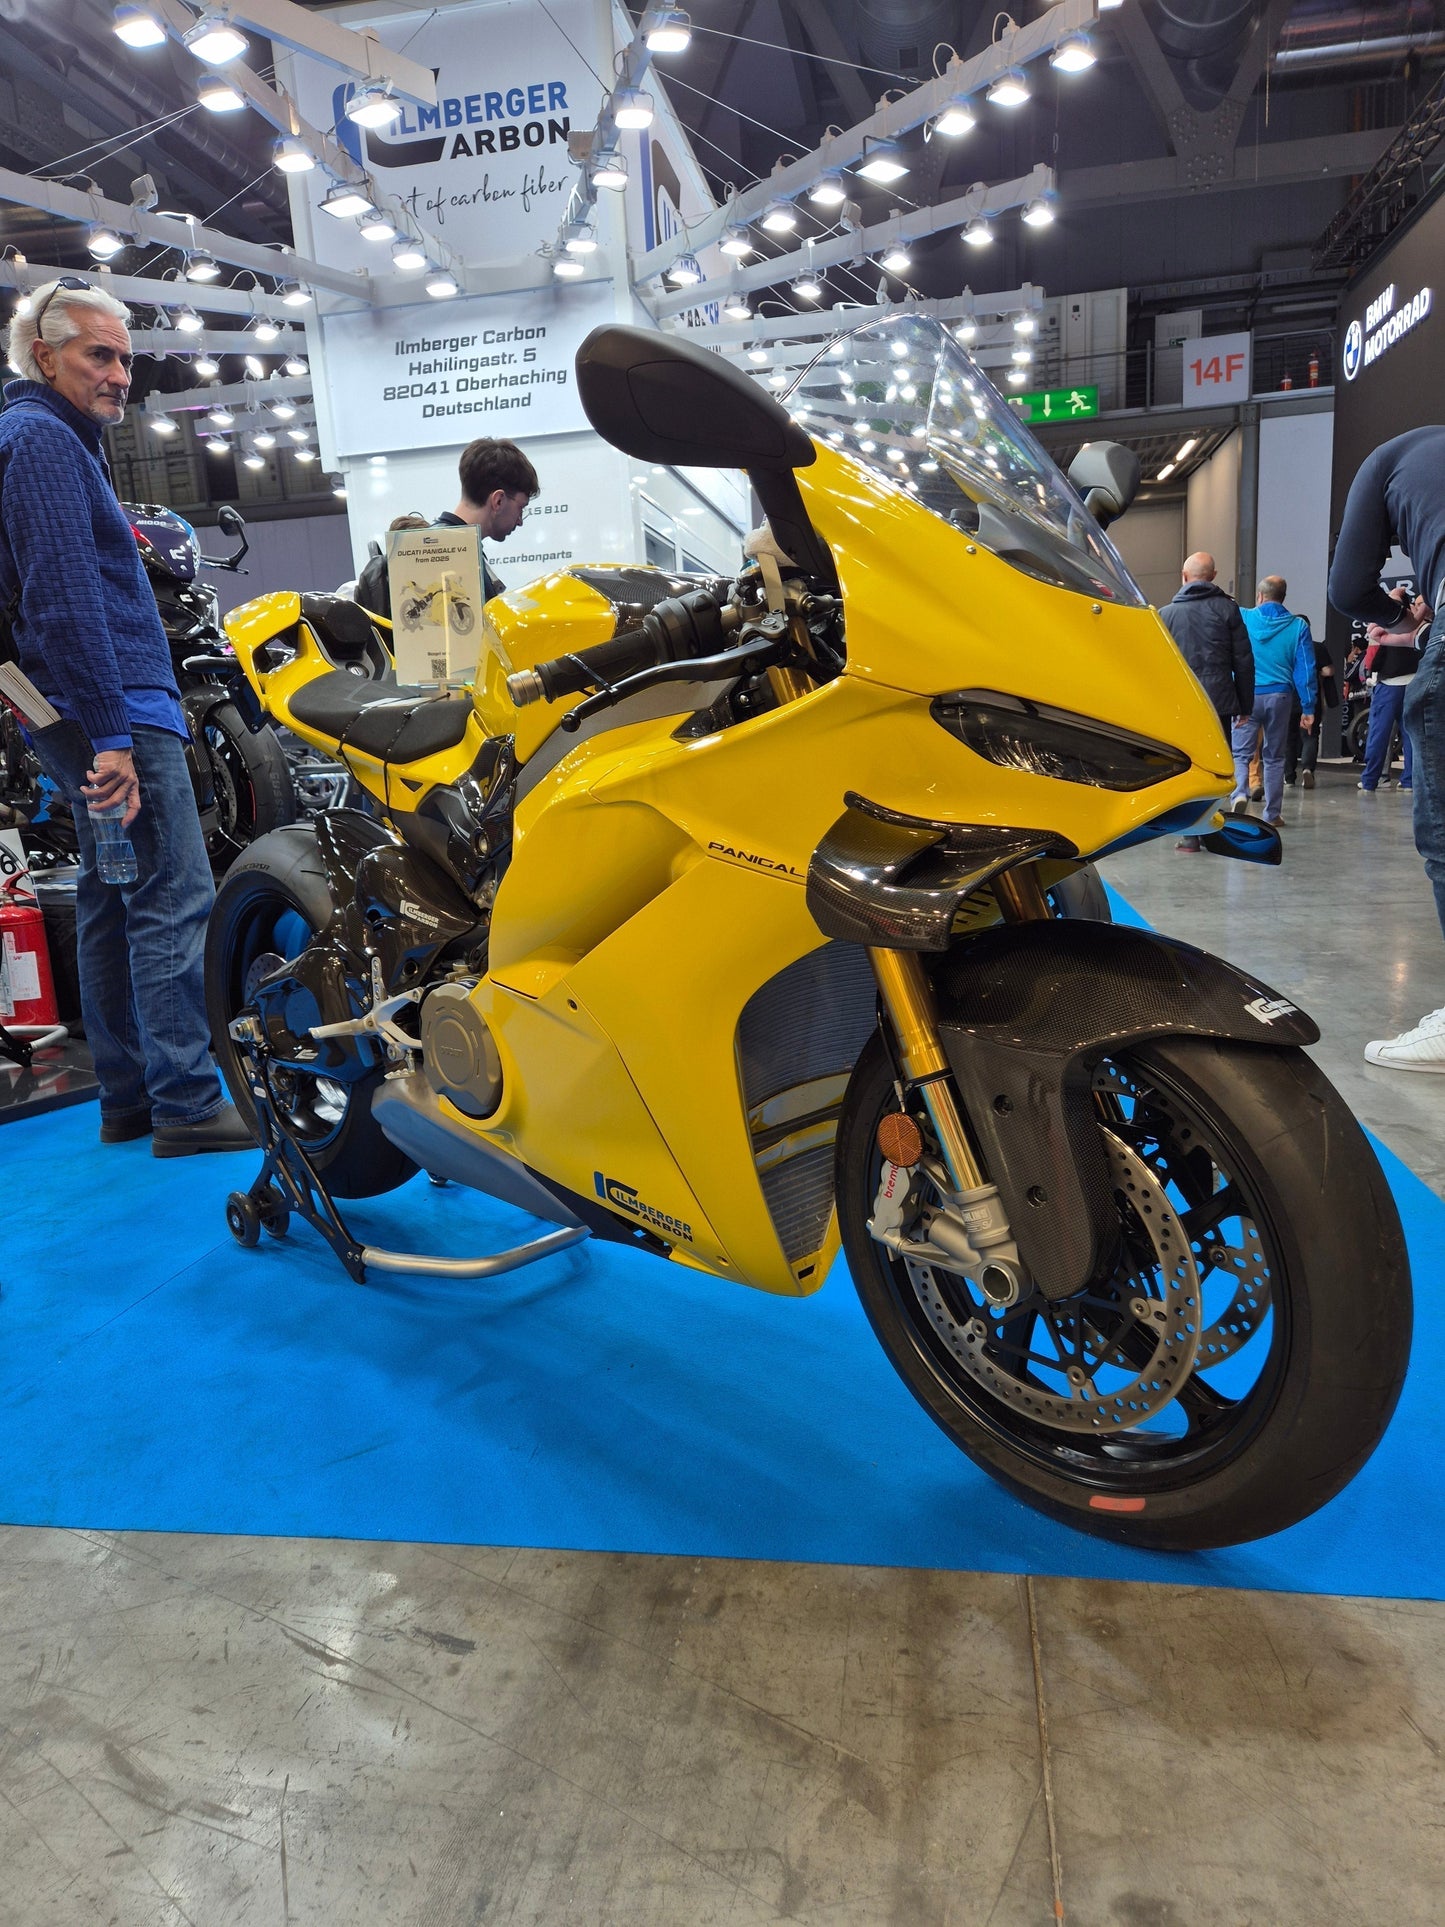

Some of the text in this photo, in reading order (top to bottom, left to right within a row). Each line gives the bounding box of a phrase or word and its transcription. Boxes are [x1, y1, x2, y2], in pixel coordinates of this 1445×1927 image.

[426, 186, 447, 224] of
[450, 173, 516, 207] carbon
[520, 165, 569, 213] fiber
[1365, 283, 1395, 333] BMW
[395, 326, 546, 355] Ilmberger Carbon
[1364, 287, 1431, 367] MOTORRAD
[409, 347, 537, 376] Hahilingastr. 5
[1189, 353, 1244, 386] 14F
[383, 368, 567, 401] 82041 Oberhaching
[422, 392, 531, 418] Deutschland
[422, 547, 456, 555] PANIGALE
[489, 550, 572, 564] er.carbonparts
[708, 841, 806, 878] PANIGAL
[884, 1163, 900, 1199] bremb
[615, 1190, 692, 1234] ILMBERGER
